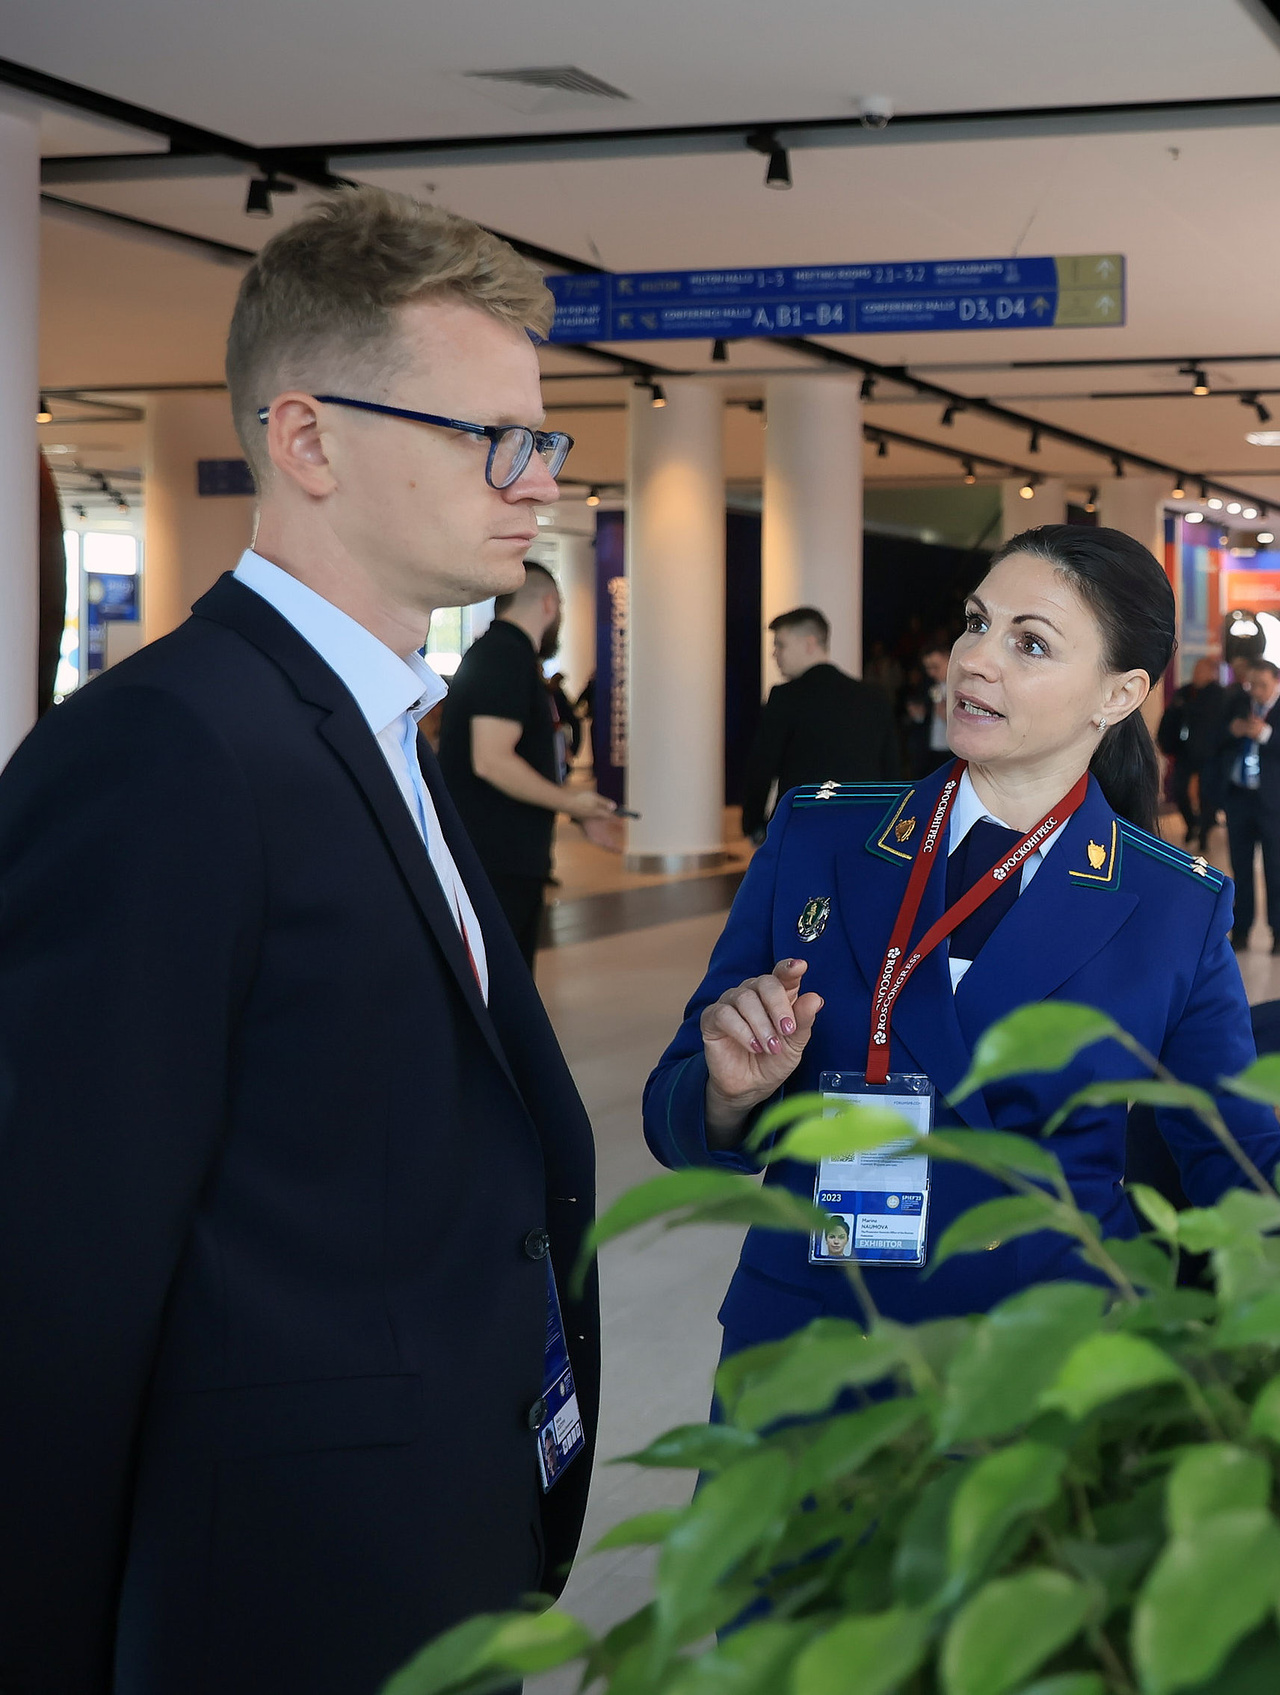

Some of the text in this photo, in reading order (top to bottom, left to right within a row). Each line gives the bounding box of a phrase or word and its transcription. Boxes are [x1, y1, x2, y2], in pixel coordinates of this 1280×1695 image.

[922, 788, 955, 854] РОСКОНГРЕСС
[1002, 815, 1058, 873] РОСКОНГРЕСС
[876, 952, 921, 1031] ROSCONGRESS
[821, 1193, 843, 1203] 2023
[859, 1240, 903, 1249] EXHIBITOR
